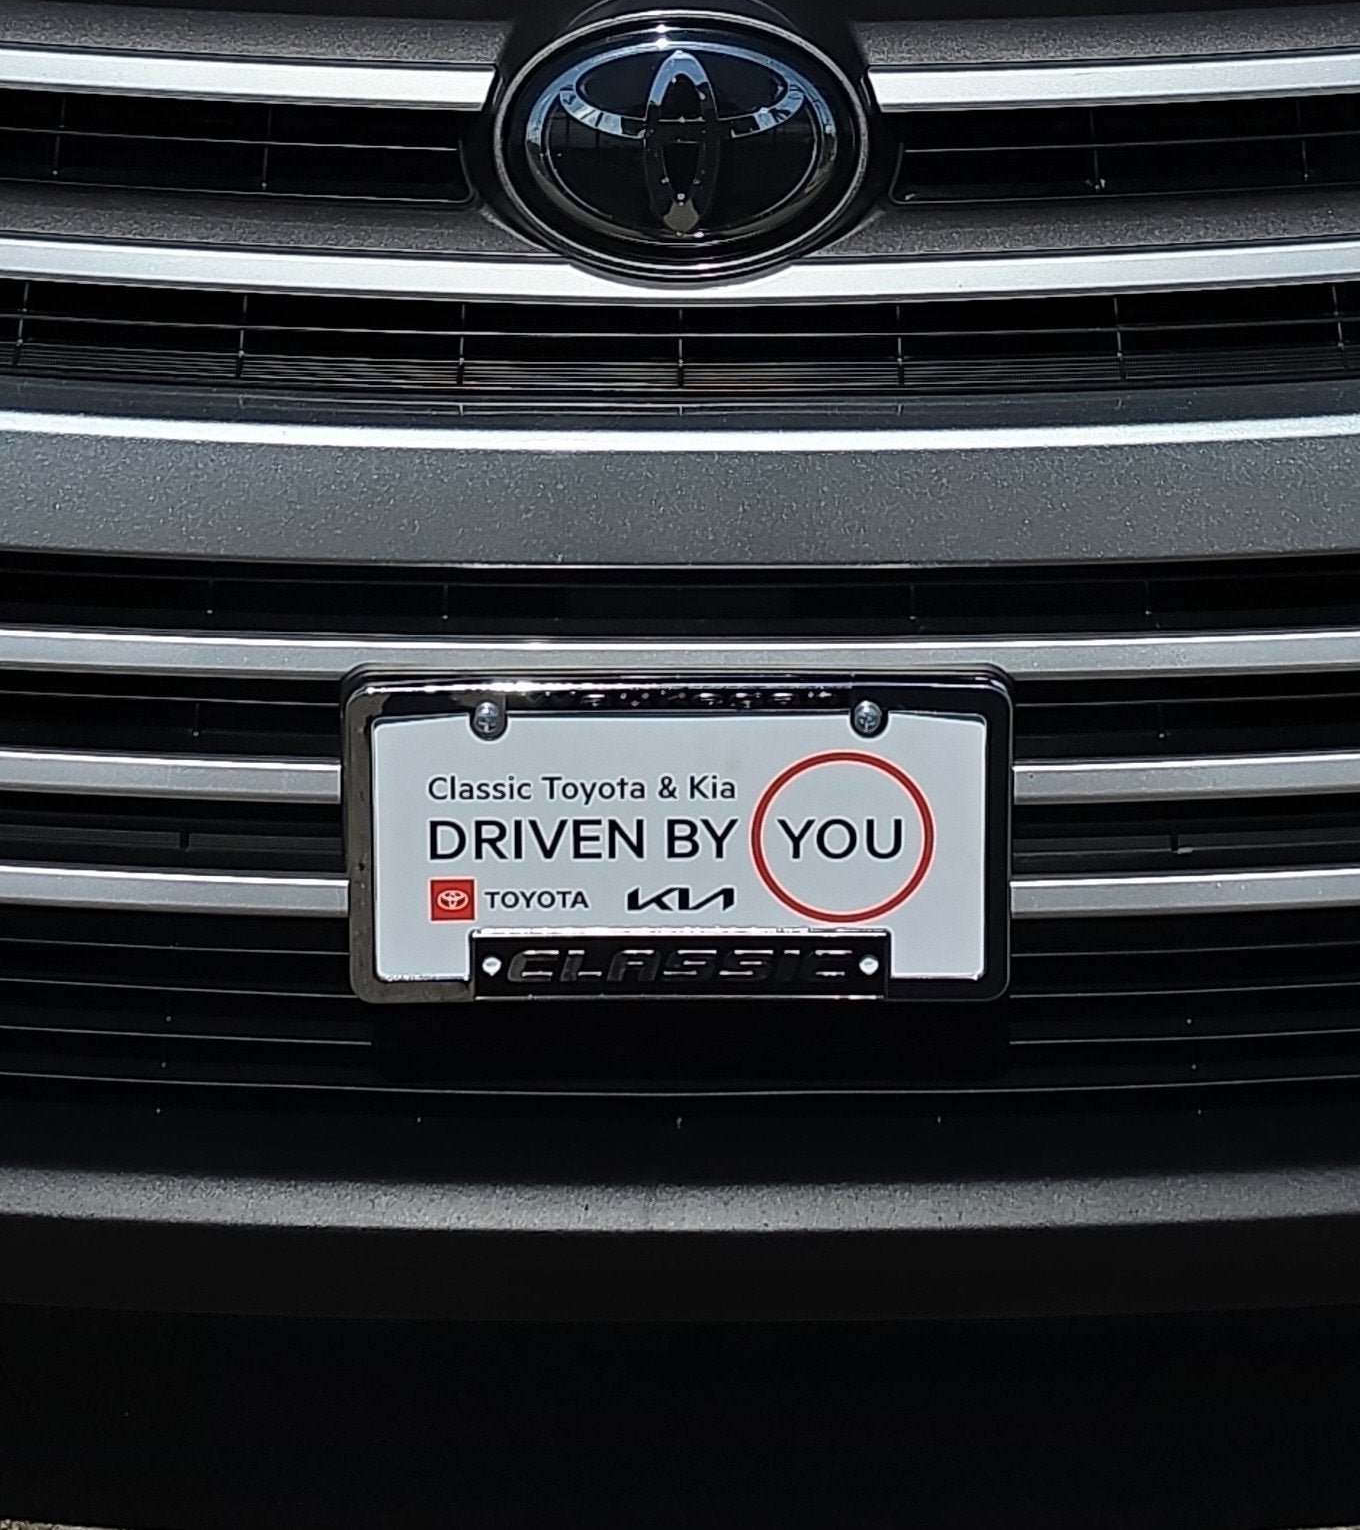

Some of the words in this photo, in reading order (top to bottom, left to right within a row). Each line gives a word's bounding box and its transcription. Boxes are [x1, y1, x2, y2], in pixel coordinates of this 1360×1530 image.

[427, 775, 533, 801] Classic
[540, 775, 646, 805] Toyota
[657, 775, 678, 800] &
[689, 774, 736, 800] Kia
[428, 818, 645, 861] DRIVEN
[666, 818, 739, 859] BY
[776, 818, 903, 860] YOU
[484, 889, 590, 909] TOYOTA
[506, 948, 854, 984] CLASSIC
